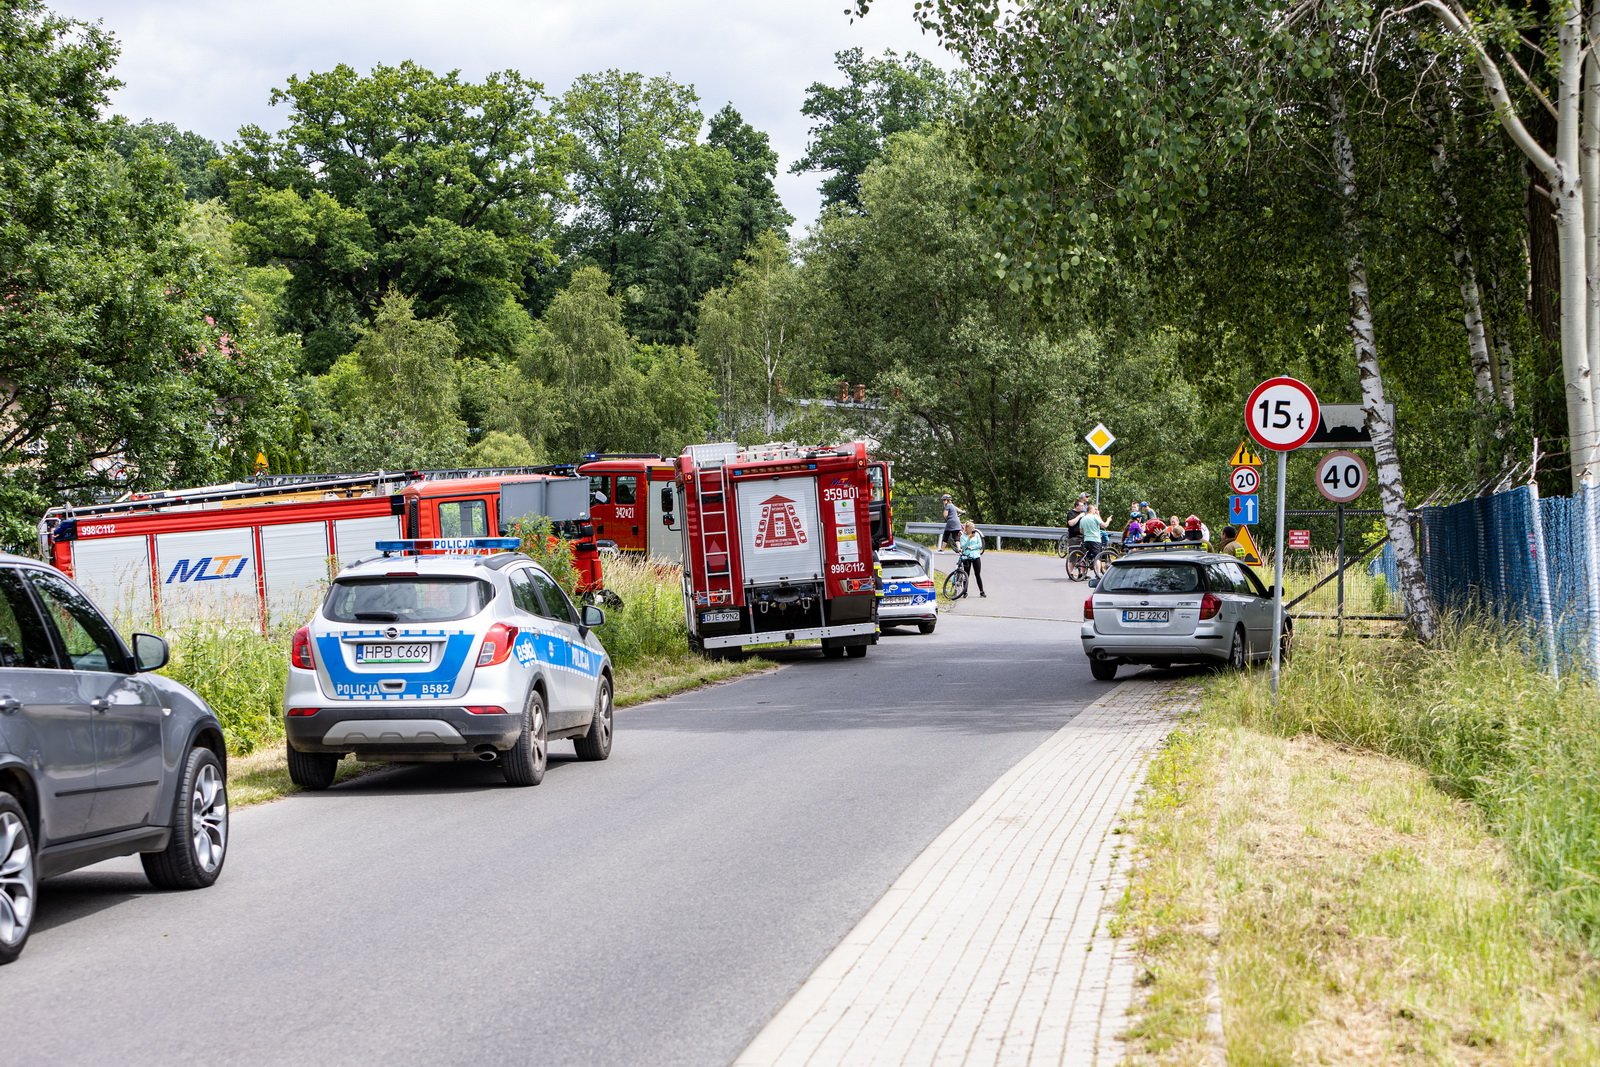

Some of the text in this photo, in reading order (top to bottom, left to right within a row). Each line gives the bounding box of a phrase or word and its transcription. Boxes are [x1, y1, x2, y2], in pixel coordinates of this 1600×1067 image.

[1258, 400, 1304, 430] 15 t
[1236, 472, 1255, 488] 20
[1323, 464, 1360, 489] 40
[434, 540, 475, 549] POLICJA
[706, 612, 739, 622] DJE 99N2
[1127, 611, 1167, 620] DJE 22K4
[365, 646, 392, 659] HPB
[397, 645, 429, 658] C669
[337, 684, 449, 695] POLICJA B582
